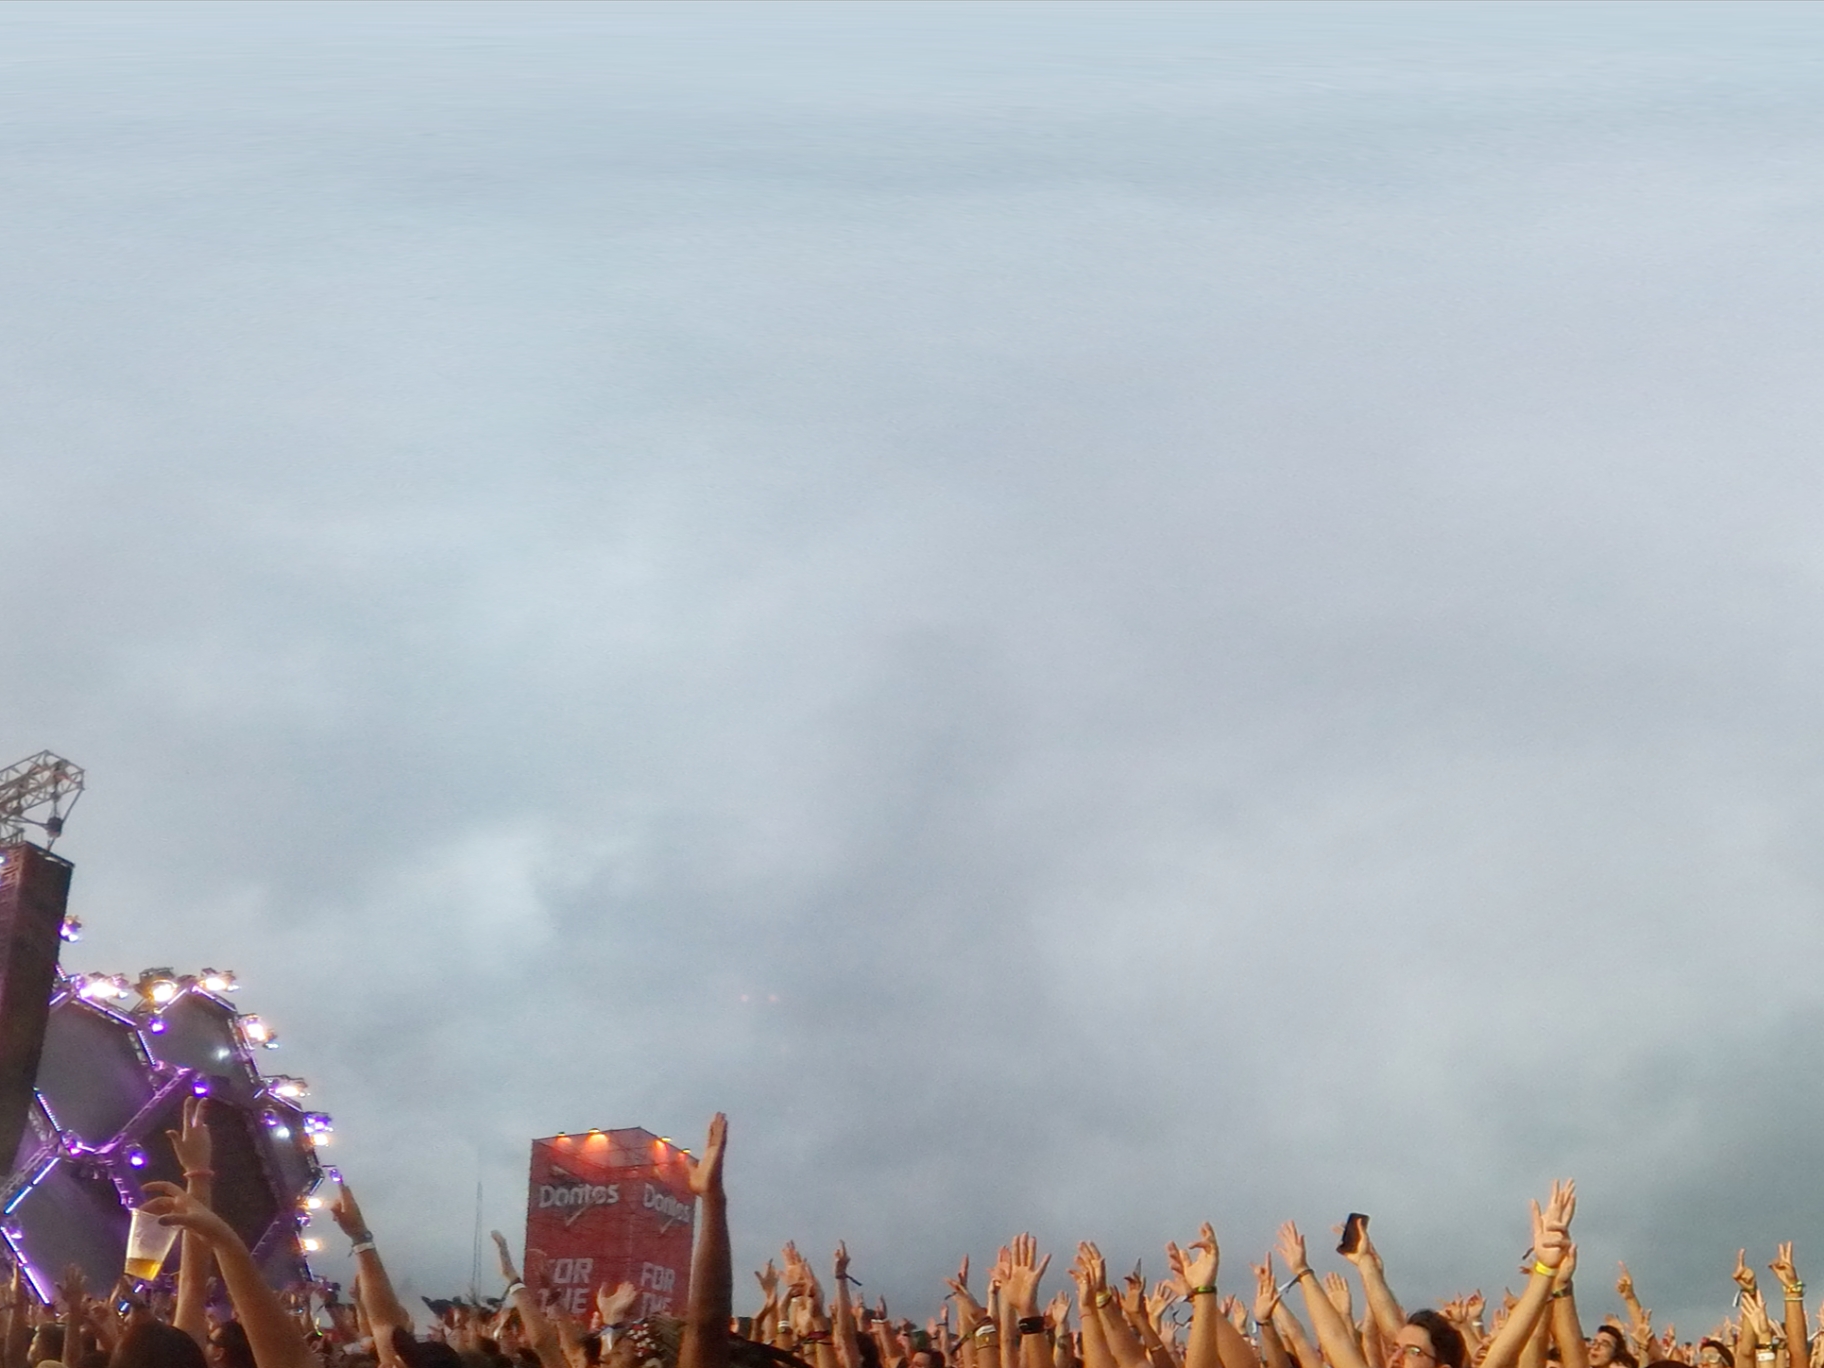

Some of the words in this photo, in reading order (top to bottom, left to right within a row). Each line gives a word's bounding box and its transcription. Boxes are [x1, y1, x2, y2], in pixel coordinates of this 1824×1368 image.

[538, 1183, 620, 1208] Doritos
[549, 1257, 594, 1284] OR
[641, 1261, 676, 1293] FOR
